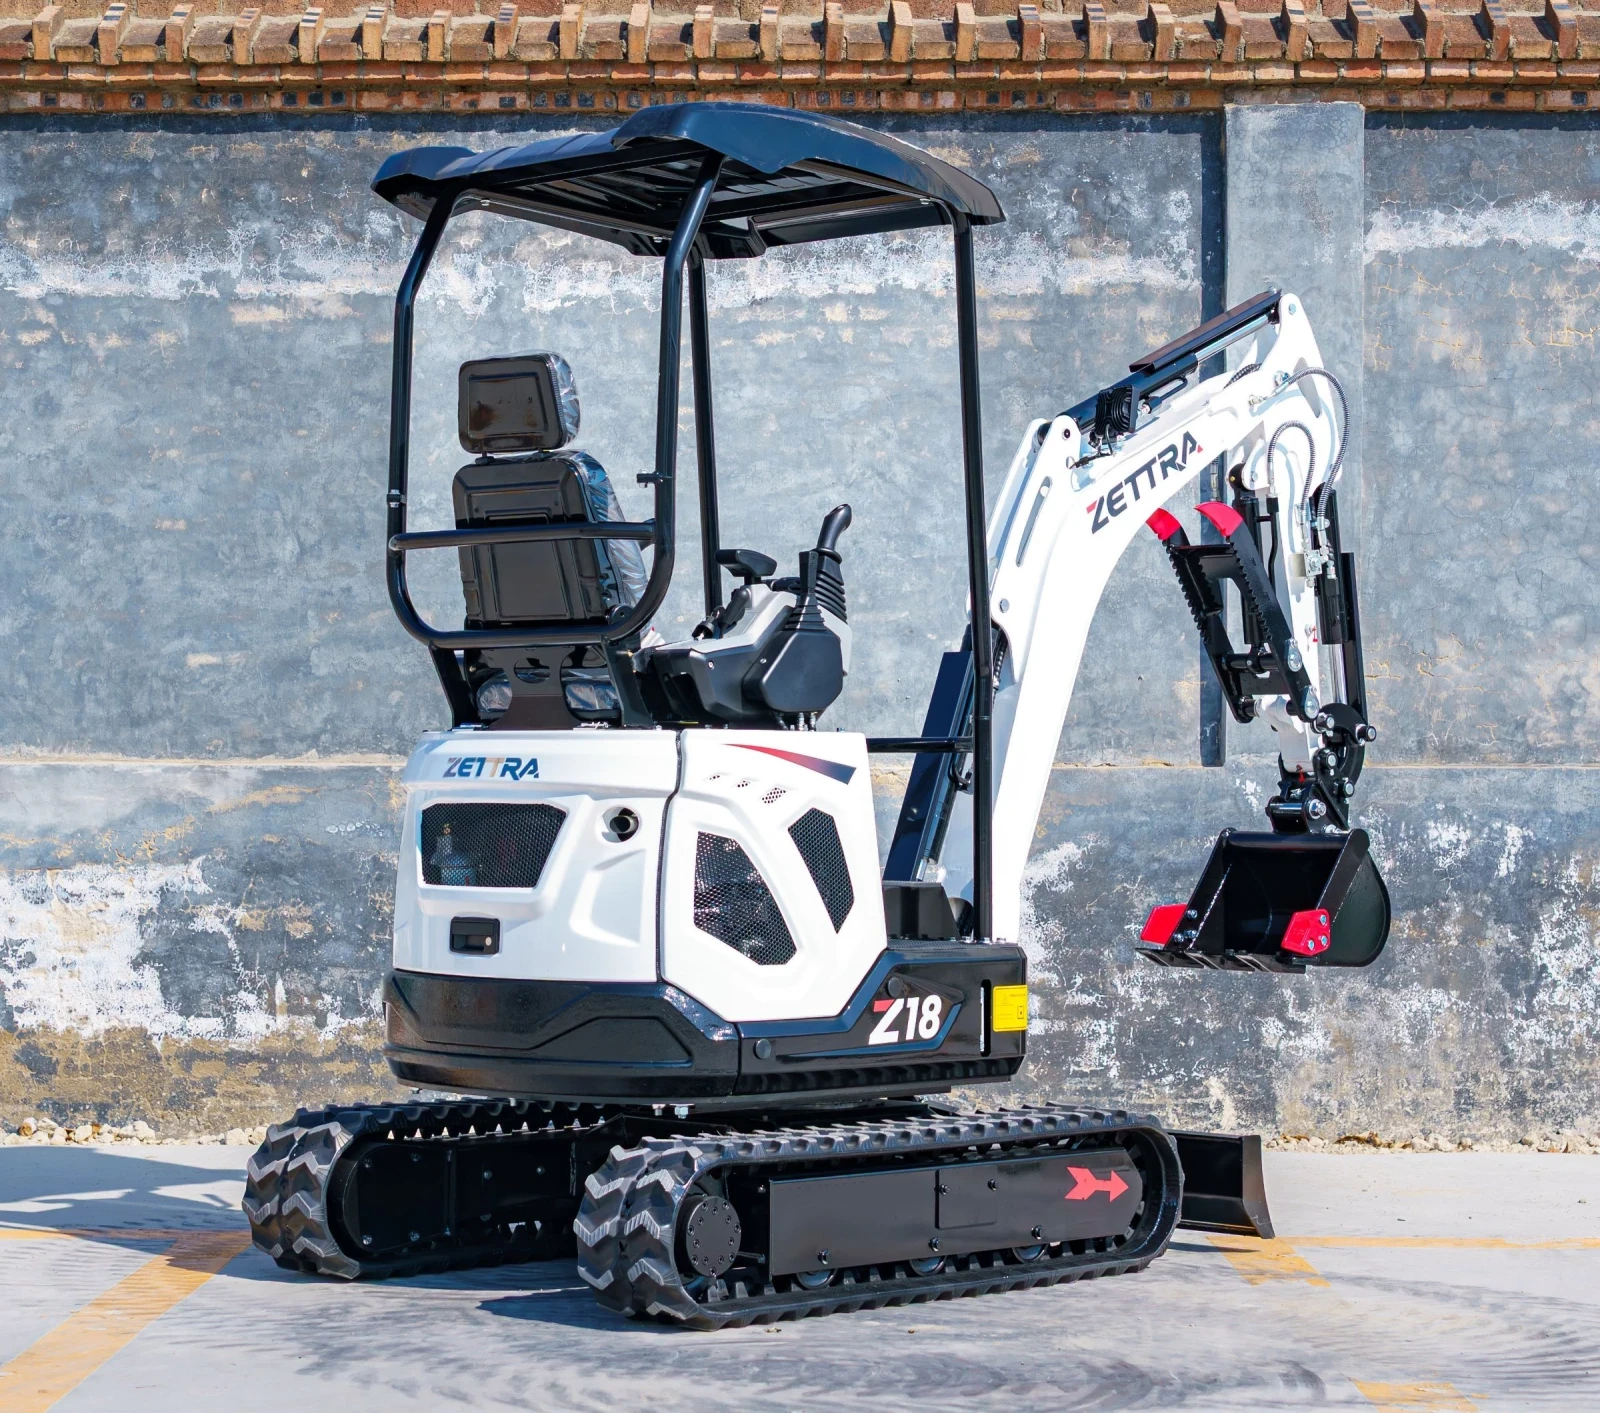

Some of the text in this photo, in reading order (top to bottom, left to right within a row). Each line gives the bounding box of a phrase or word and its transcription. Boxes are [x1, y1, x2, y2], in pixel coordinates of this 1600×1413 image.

[1086, 431, 1203, 534] ZETTRA
[443, 757, 539, 780] ZETTRA
[868, 994, 942, 1045] Z18
